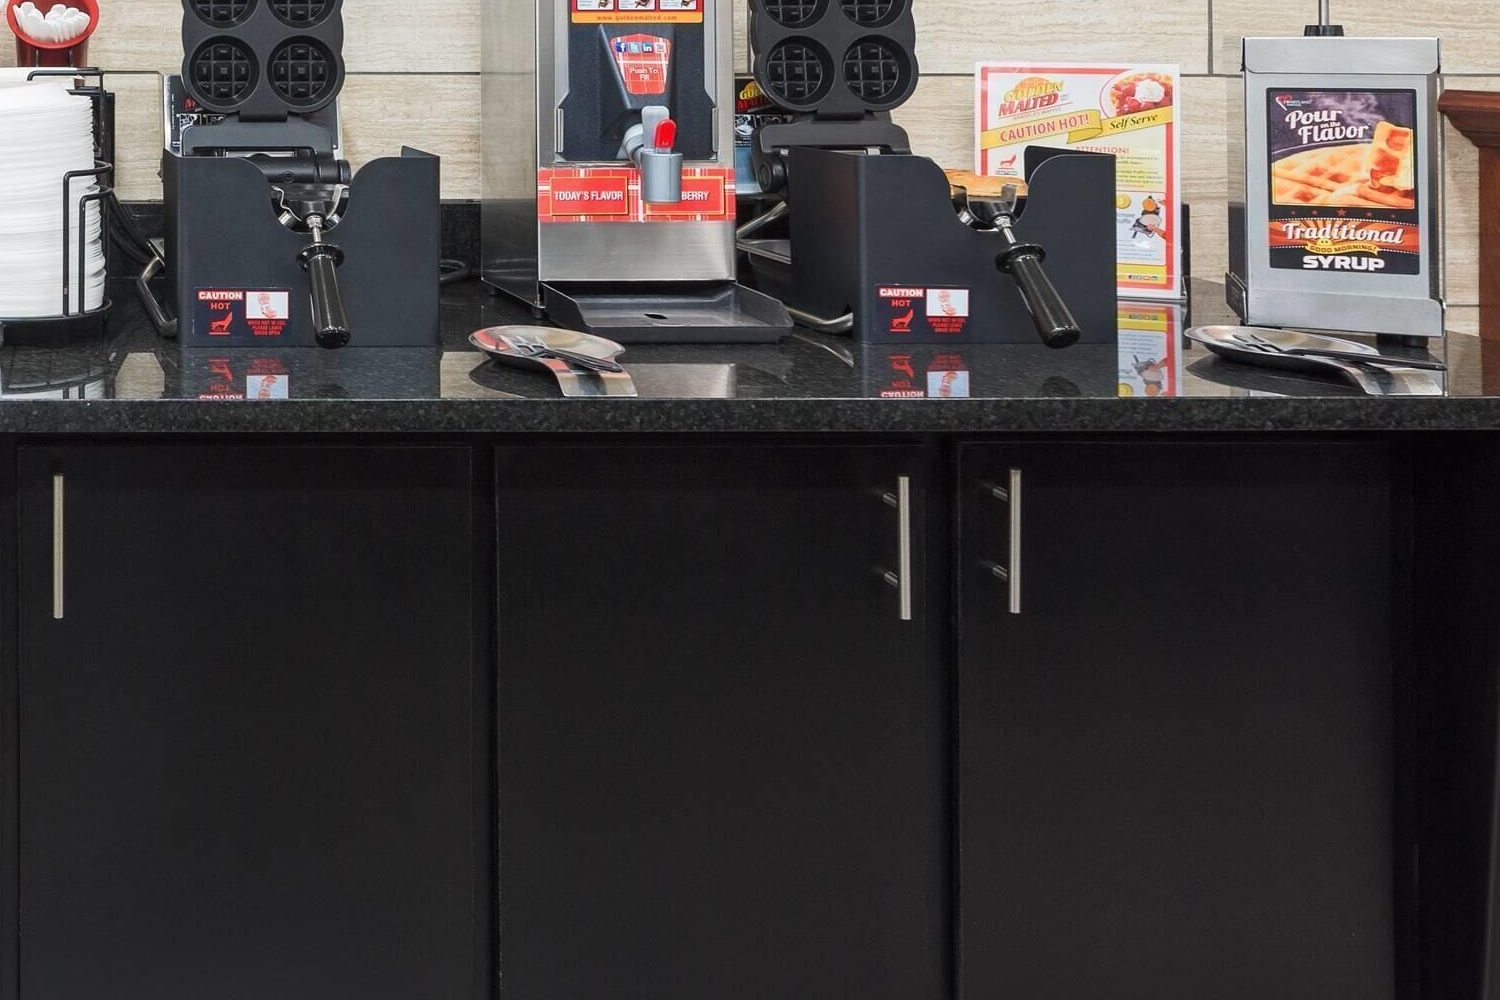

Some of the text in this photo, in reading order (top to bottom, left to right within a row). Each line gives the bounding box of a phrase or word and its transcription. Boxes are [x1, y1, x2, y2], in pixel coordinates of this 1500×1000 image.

[1004, 80, 1065, 102] GOLDEN
[998, 93, 1059, 116] MALTED
[1000, 113, 1090, 142] CAUTION HOT!
[1109, 114, 1158, 130] Self Serve
[1285, 110, 1342, 129] Pour
[1298, 125, 1369, 144] Flavor
[1076, 146, 1129, 154] ATTENTION!
[554, 190, 623, 200] TODAY'S FLAVOR
[681, 191, 709, 200] BERRY
[1282, 223, 1404, 244] Traditional
[1310, 244, 1377, 253] GOOD MORNING!
[1303, 255, 1385, 271] SYRUP
[199, 291, 243, 300] CAUTION
[880, 289, 924, 297] CAUTION
[210, 302, 230, 310] HOT
